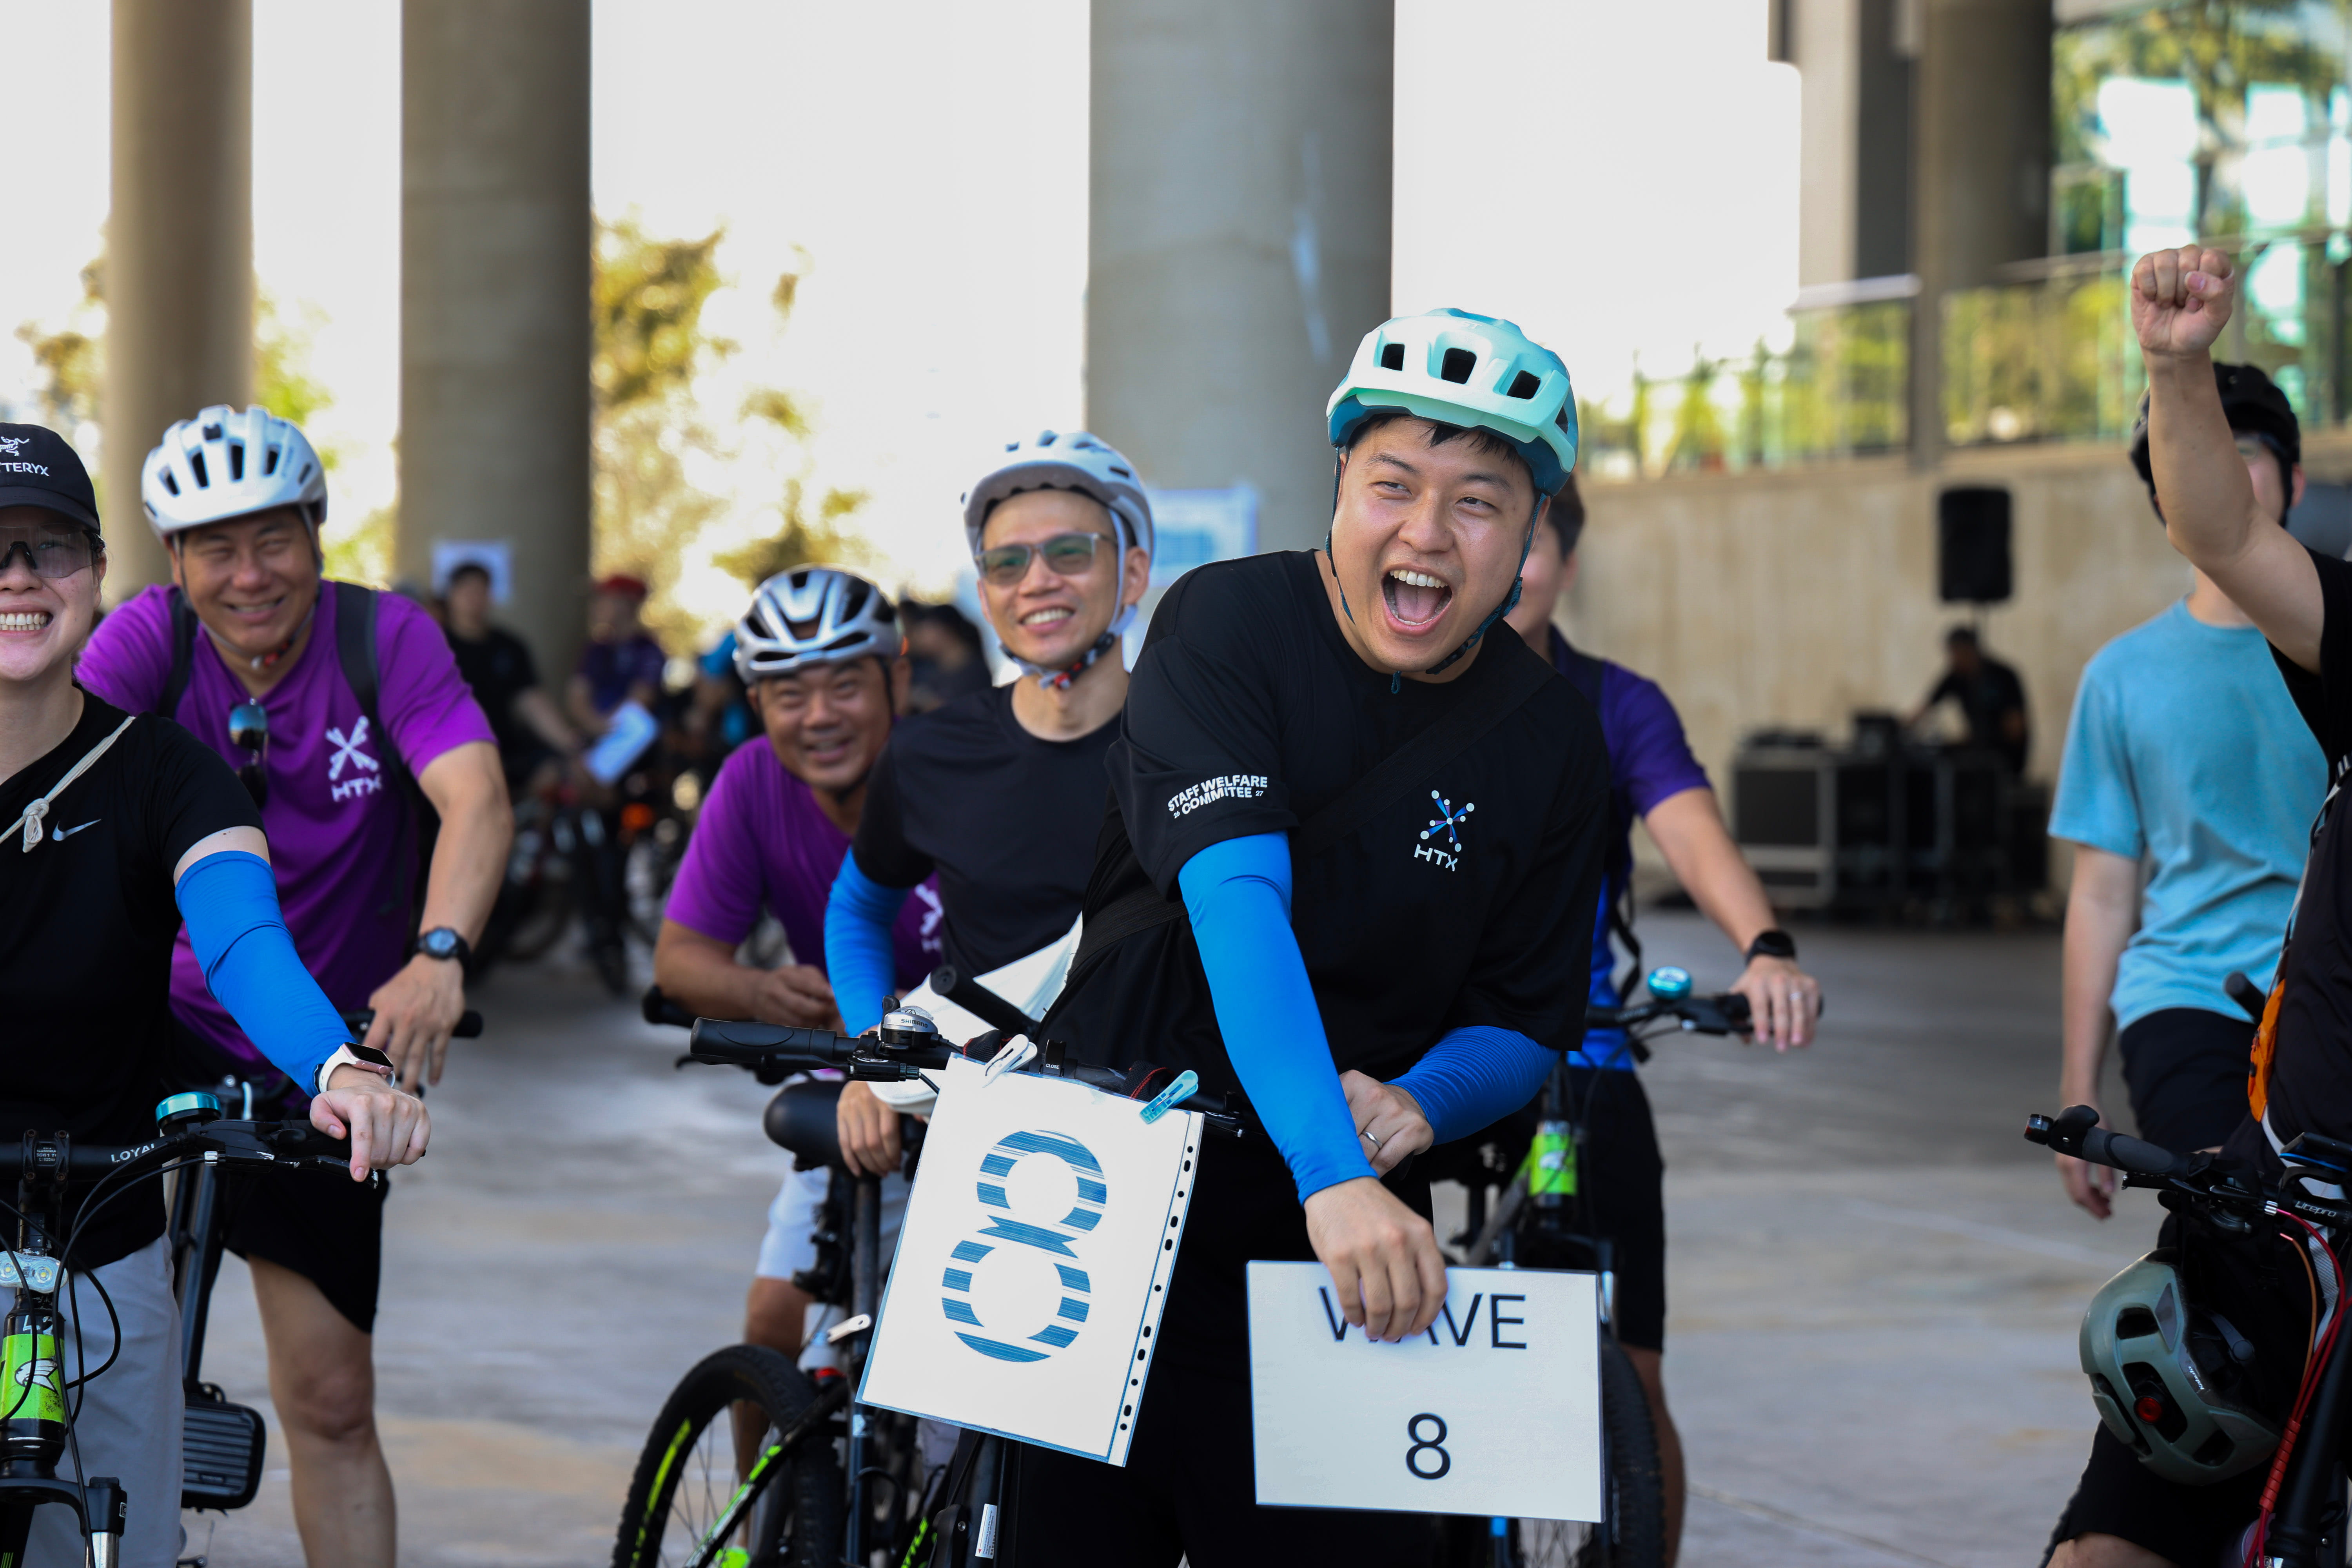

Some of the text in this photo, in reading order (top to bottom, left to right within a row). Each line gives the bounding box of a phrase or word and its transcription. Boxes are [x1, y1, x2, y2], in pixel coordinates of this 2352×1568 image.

[331, 774, 382, 802] HTX
[1168, 775, 1268, 811] STAFF WELFARE
[1181, 786, 1252, 815] COMMITEE
[1414, 844, 1458, 872] HTX
[901, 1018, 928, 1028] SHIMANO
[2294, 1200, 2337, 1217] Litepro
[941, 1129, 1107, 1363] 8
[1405, 1412, 1451, 1480] 8
